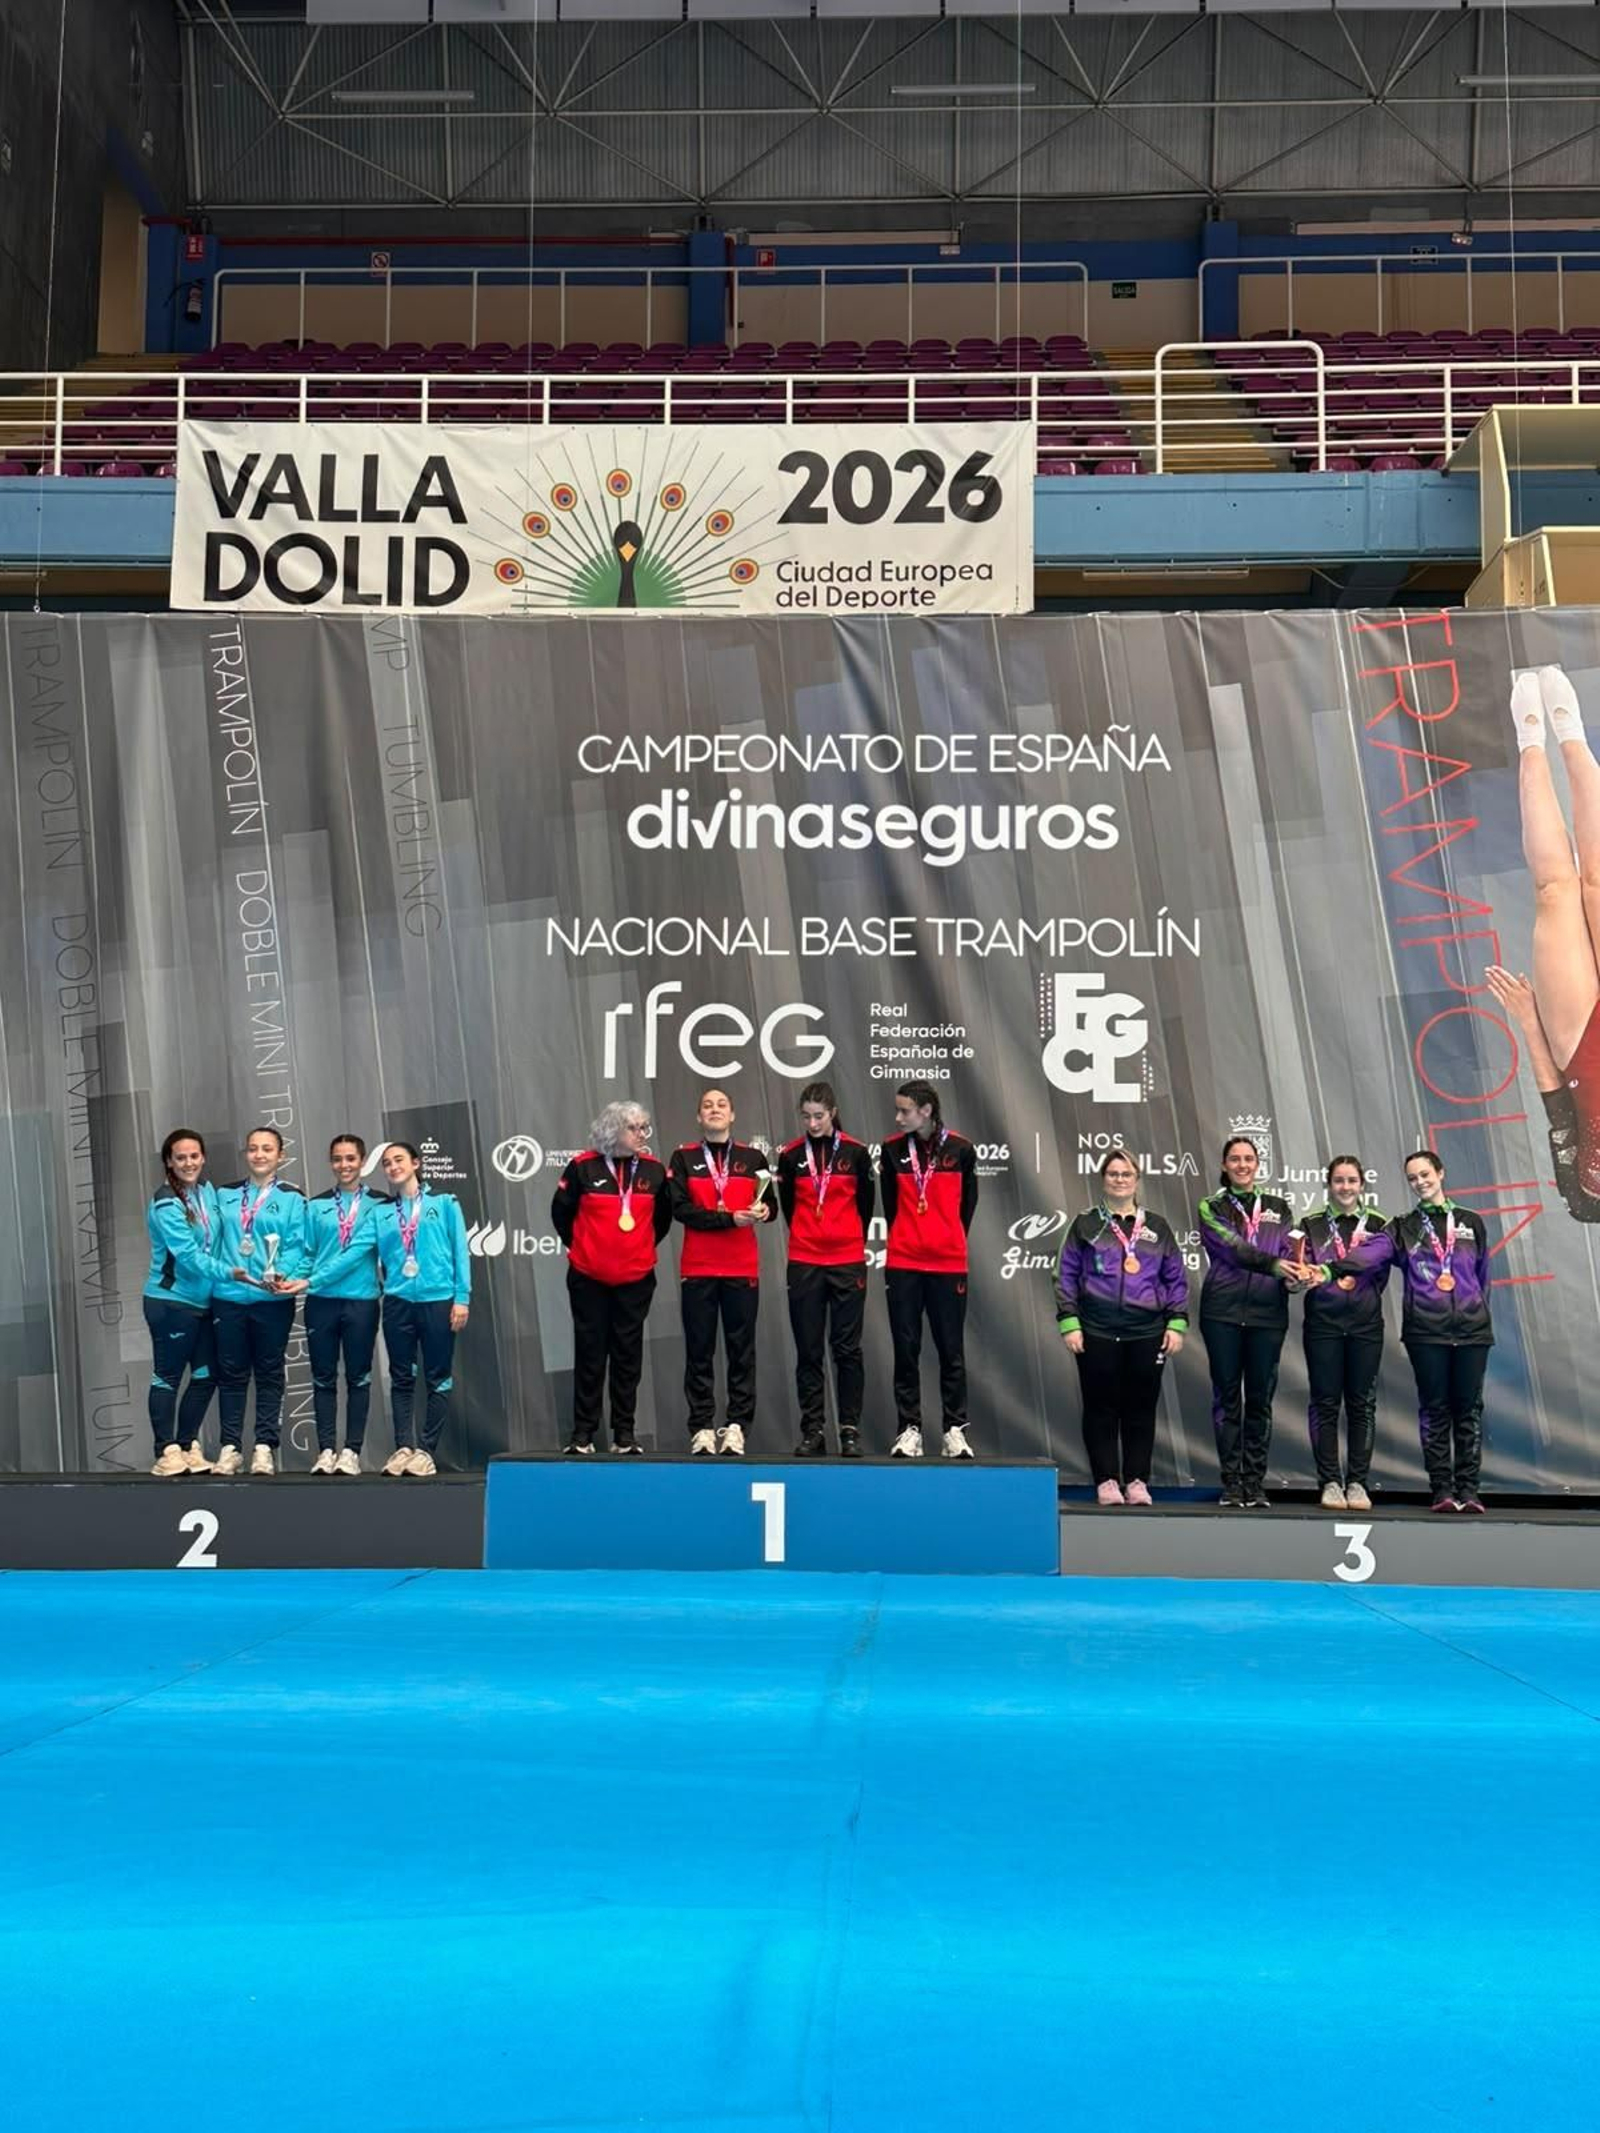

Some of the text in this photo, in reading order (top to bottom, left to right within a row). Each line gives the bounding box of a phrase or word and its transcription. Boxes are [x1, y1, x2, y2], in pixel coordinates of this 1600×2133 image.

[202, 450, 468, 524] VALLA
[777, 449, 1003, 525] 2026
[203, 531, 470, 607] DOLID
[776, 560, 993, 587] Ciudad Europea
[776, 585, 937, 609] del Deporte
[578, 723, 1172, 775] CAMPEONATO DE ESPAÑA
[383, 714, 442, 938] TUMBLING
[626, 788, 1120, 867] divinaseguros
[236, 870, 280, 993] DOBLE
[546, 906, 1201, 957] NACIONAL BASE TRAMPOLÍN
[870, 1002, 908, 1018] Real
[870, 1023, 967, 1038] Federación
[250, 1000, 289, 1077] MINI
[870, 1044, 975, 1061] Española de
[869, 1064, 951, 1080] Gimnasia
[973, 1144, 1010, 1160] 026
[1078, 1132, 1125, 1149] NOS
[1278, 1165, 1329, 1183] Junt
[1301, 1192, 1316, 1211] y
[176, 1509, 219, 1568] 2
[751, 1482, 785, 1562] 1
[1332, 1523, 1376, 1583] 3
